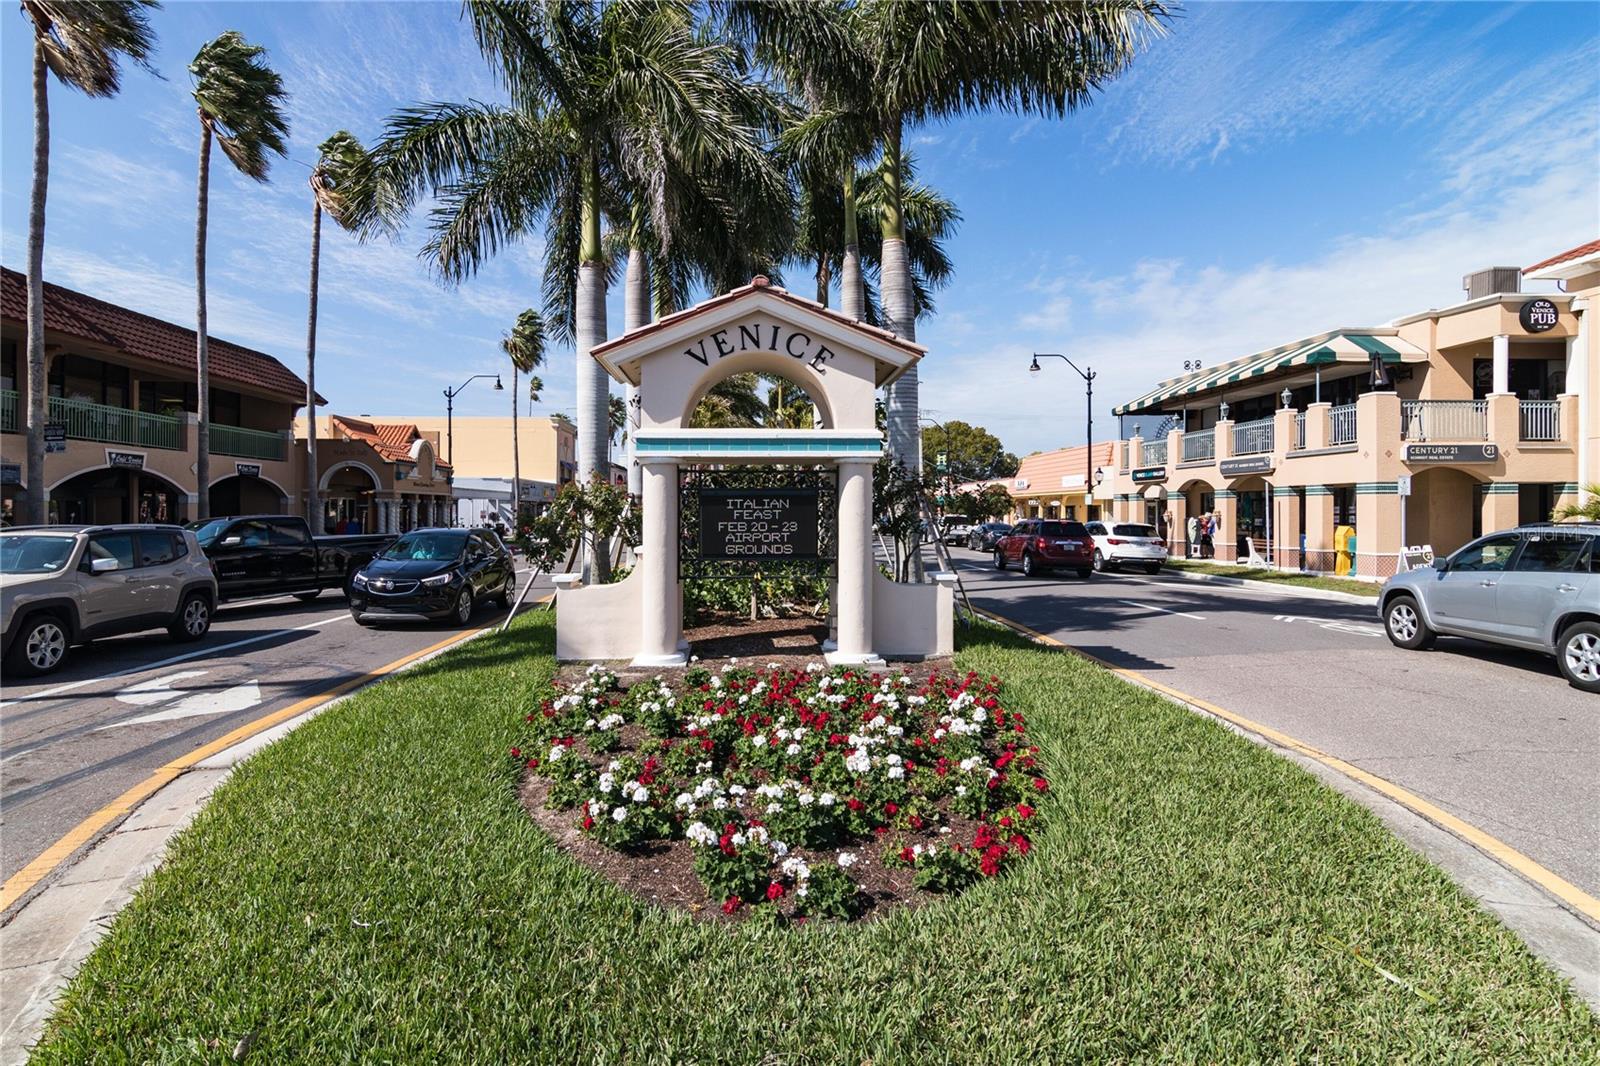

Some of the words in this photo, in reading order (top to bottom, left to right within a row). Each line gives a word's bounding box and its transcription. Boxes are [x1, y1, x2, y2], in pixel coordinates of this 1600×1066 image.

[1530, 313, 1556, 324] PUB
[684, 324, 835, 376] VENICE
[1486, 446, 1494, 454] 21
[726, 499, 790, 509] ITALIAN
[733, 510, 782, 520] FEAST
[718, 521, 748, 532] FEB
[750, 521, 768, 532] 20
[782, 521, 798, 532] 23
[725, 532, 791, 543] AIRPORT
[725, 544, 793, 555] GROUNDS
